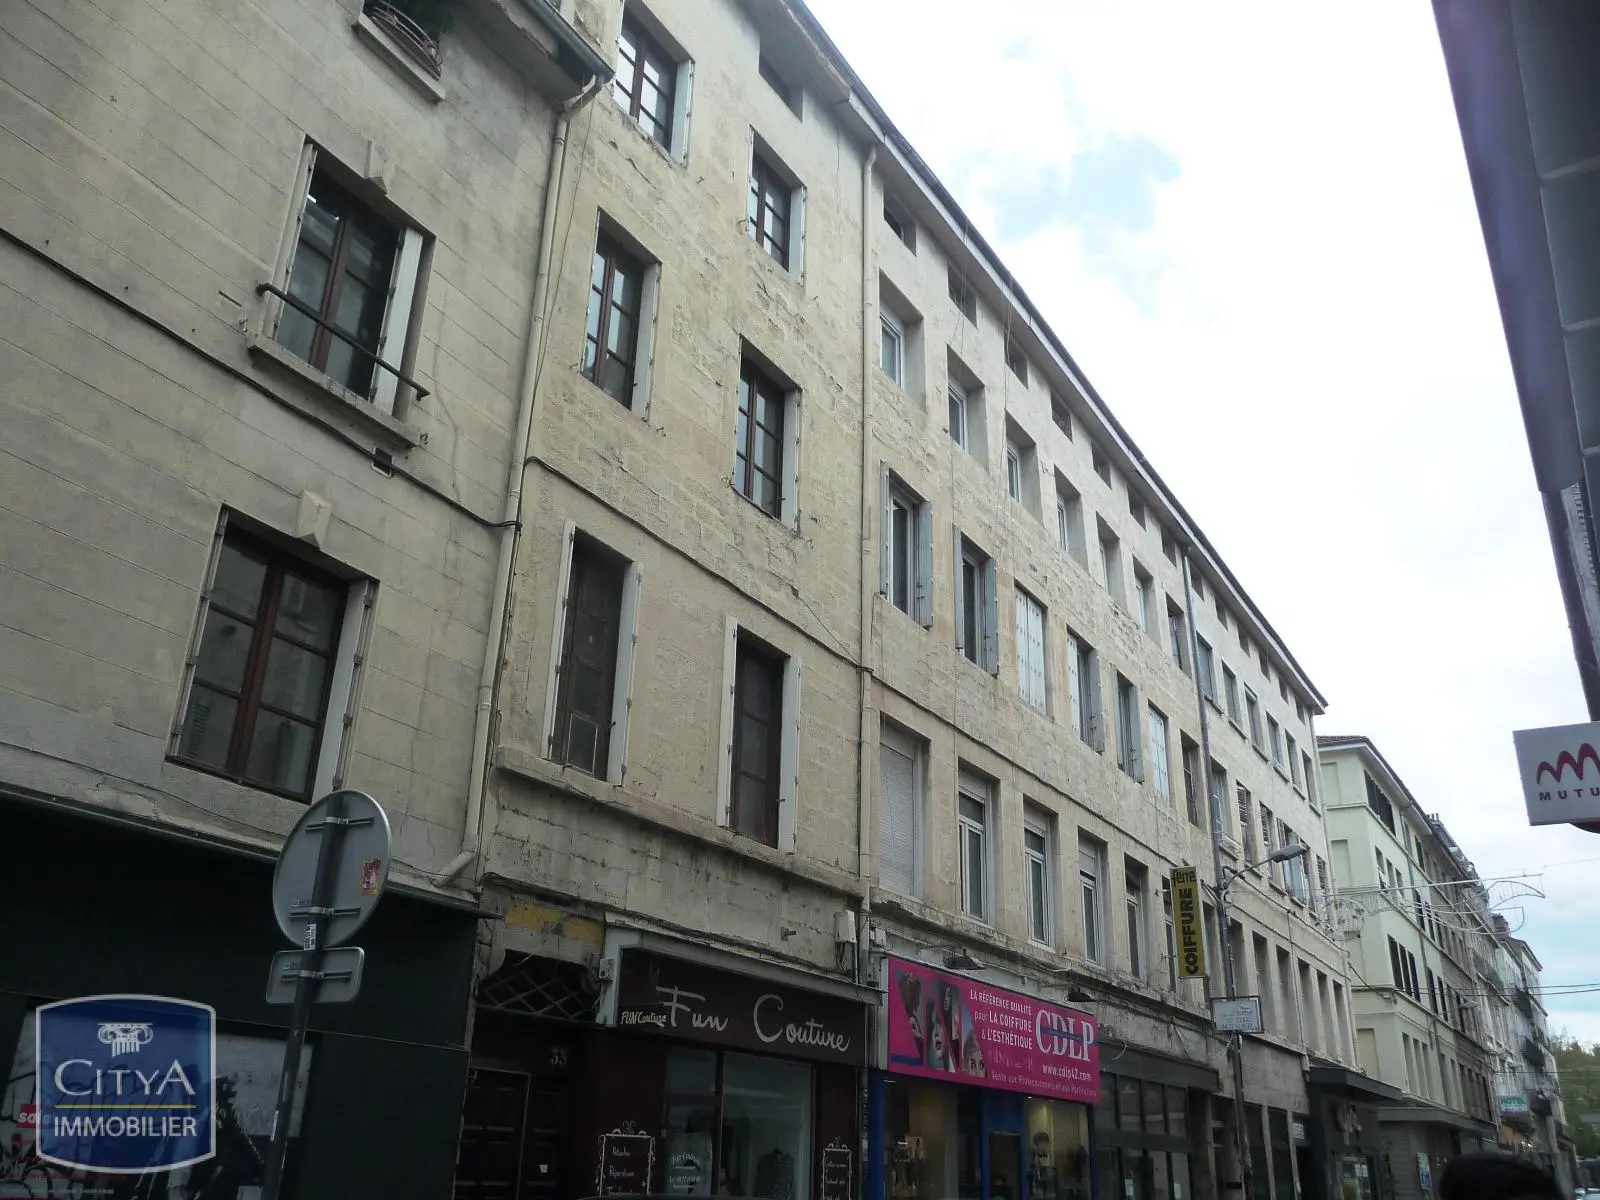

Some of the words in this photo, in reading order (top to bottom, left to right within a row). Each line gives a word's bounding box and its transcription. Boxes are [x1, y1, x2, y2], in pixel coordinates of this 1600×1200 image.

[1178, 888, 1198, 975] COIFFURE
[970, 989, 978, 1001] LA
[656, 985, 729, 1032] Fun
[753, 993, 851, 1052] Couture
[989, 1010, 998, 1024] LA
[1000, 1014, 1033, 1033] COIFFURE
[987, 1028, 1033, 1050] L'ESTHÉTIQUE
[1035, 1009, 1094, 1062] CDLP
[1042, 1064, 1092, 1081] www.cdlp42.com
